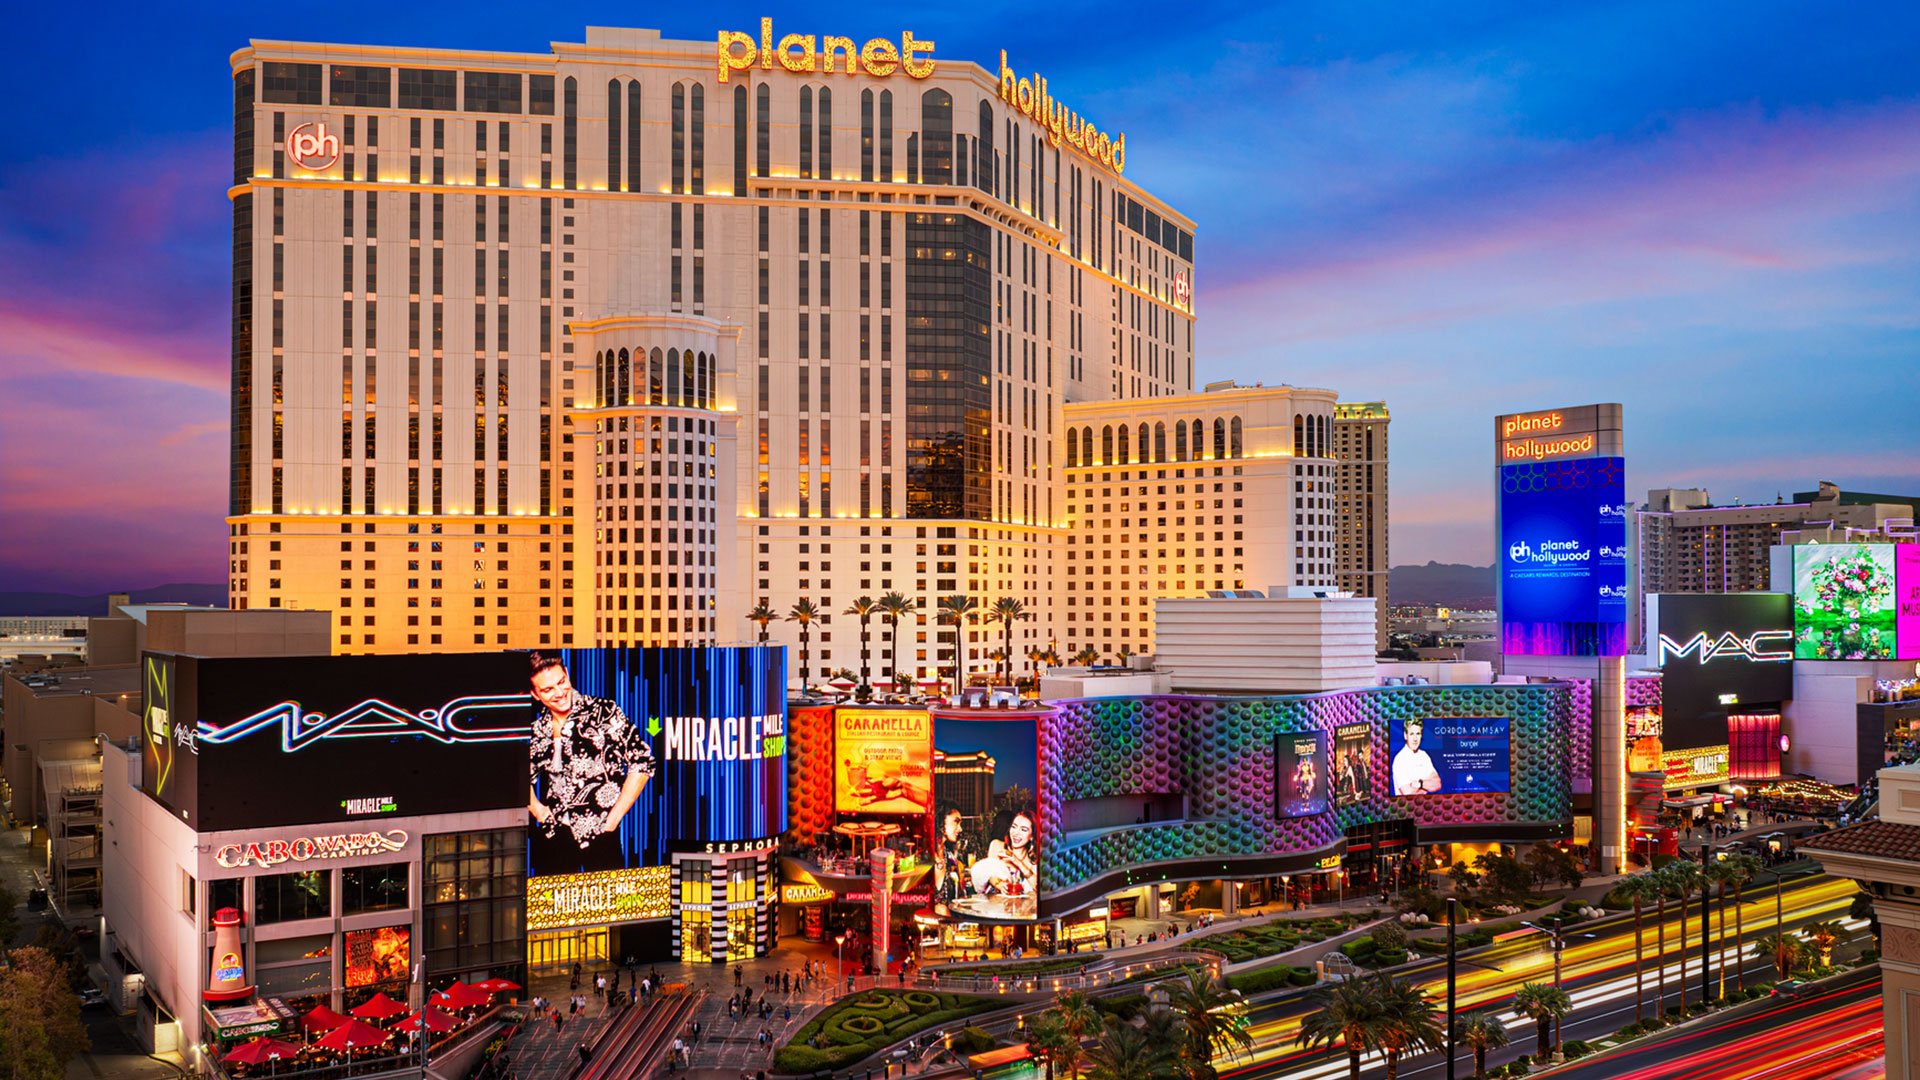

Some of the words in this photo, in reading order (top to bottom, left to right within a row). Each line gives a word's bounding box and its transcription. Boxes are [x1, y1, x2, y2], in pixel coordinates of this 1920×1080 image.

[717, 17, 936, 83] planet
[1000, 49, 1126, 174] hollywood
[294, 122, 339, 163] ph
[1505, 412, 1562, 437] planet
[1505, 434, 1593, 460] hollywood
[1511, 540, 1531, 560] ph
[1531, 549, 1591, 565] hollywood
[1540, 540, 1579, 553] planet
[762, 713, 784, 737] MILE
[844, 718, 922, 731] CARAMELLA
[1338, 725, 1370, 736] CARAMELLA
[1434, 726, 1468, 735] GORDON
[1471, 725, 1505, 735] RAMSAY
[664, 715, 762, 761] MIRACLE
[762, 734, 787, 759] SHOPS
[346, 798, 381, 815] MIRACLE
[214, 837, 316, 869] CABO
[313, 831, 384, 853] WABO
[321, 848, 379, 860] CANTINA
[705, 837, 780, 854] SEPHORA
[554, 884, 616, 914] MIRACLE
